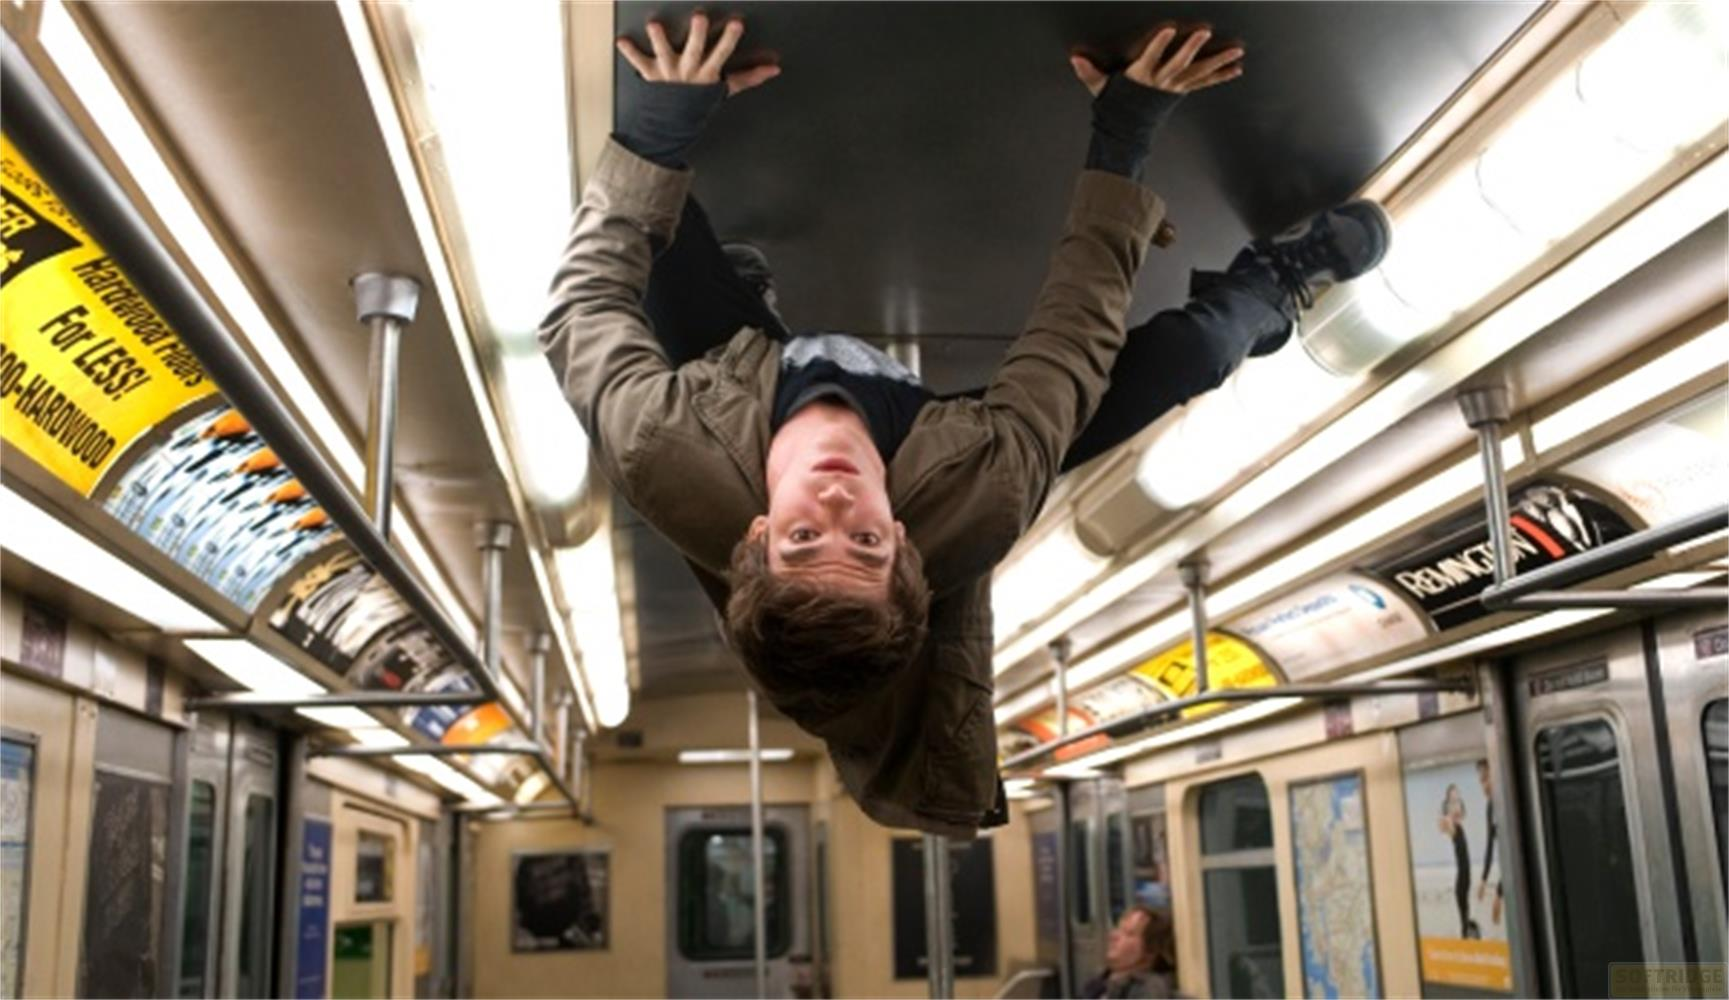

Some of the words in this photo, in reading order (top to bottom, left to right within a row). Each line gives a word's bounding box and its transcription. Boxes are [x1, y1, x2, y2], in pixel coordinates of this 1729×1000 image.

[39, 304, 96, 353] For
[73, 337, 151, 402] LESS!
[0, 343, 116, 470] 00-HARDWOOD
[1395, 527, 1538, 599] REMINGTN
